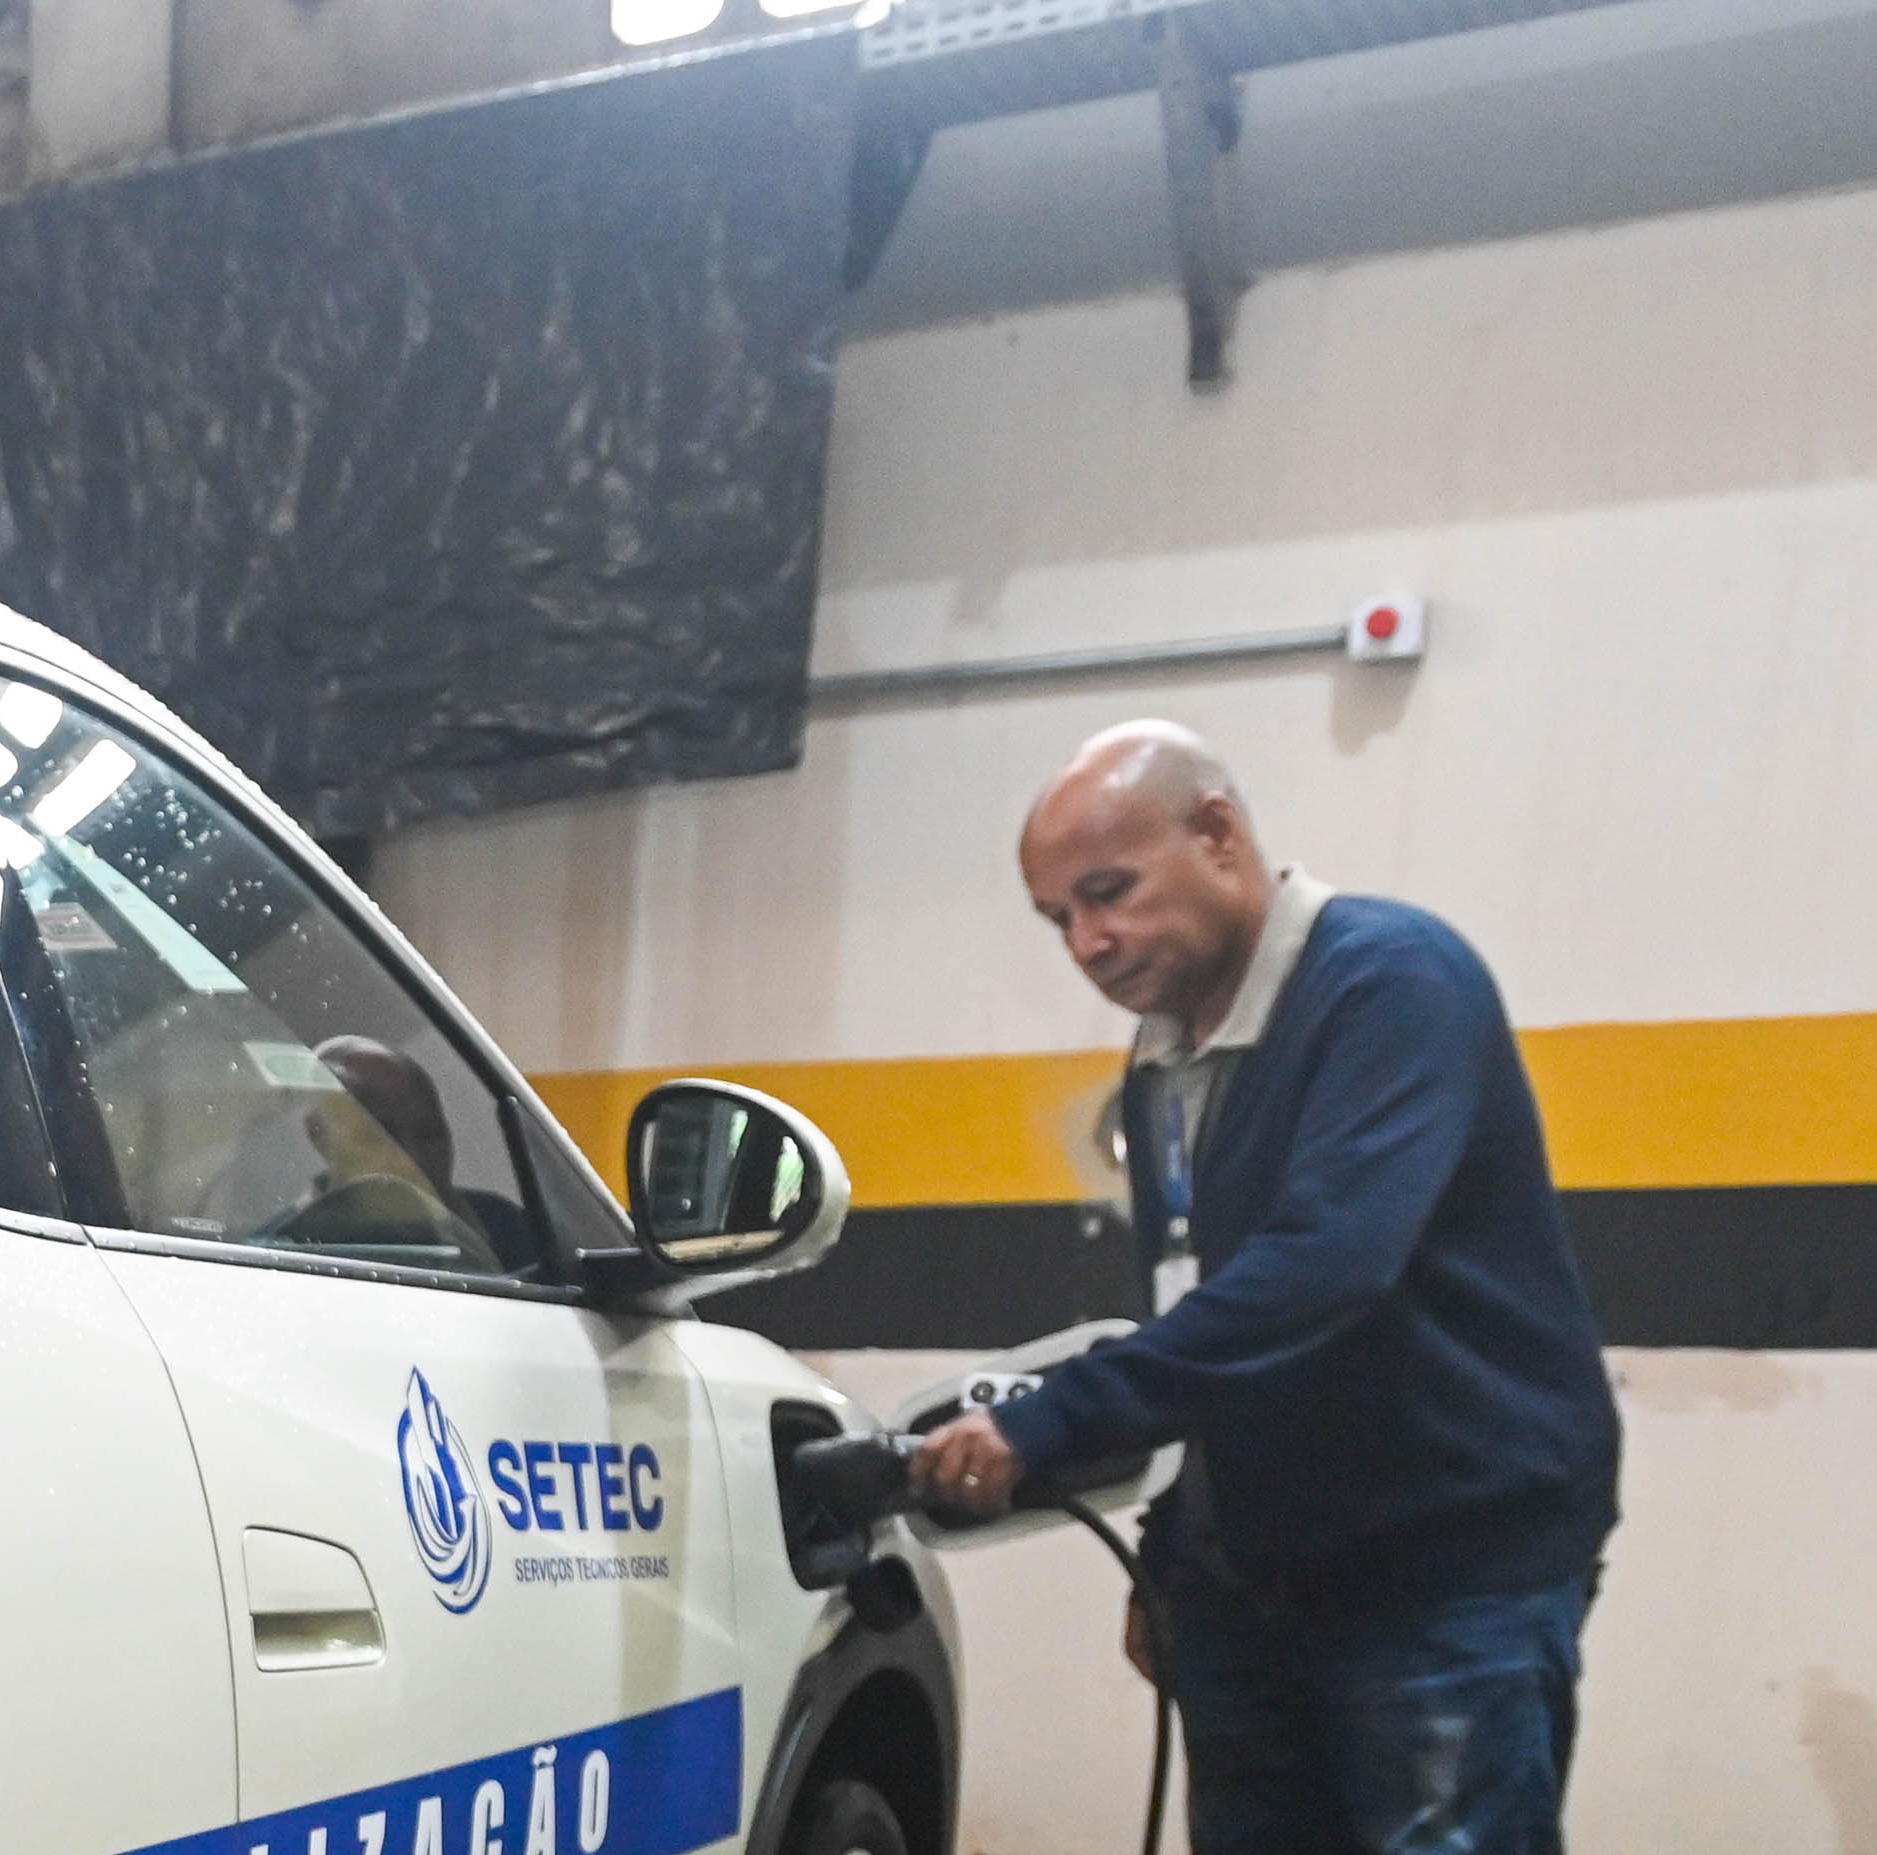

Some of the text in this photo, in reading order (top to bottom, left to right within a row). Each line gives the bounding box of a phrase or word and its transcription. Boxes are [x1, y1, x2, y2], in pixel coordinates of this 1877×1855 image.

[488, 1438, 665, 1532] SETEC
[515, 1556, 575, 1587] SERVIÇOS
[630, 1556, 670, 1579] GERAIS
